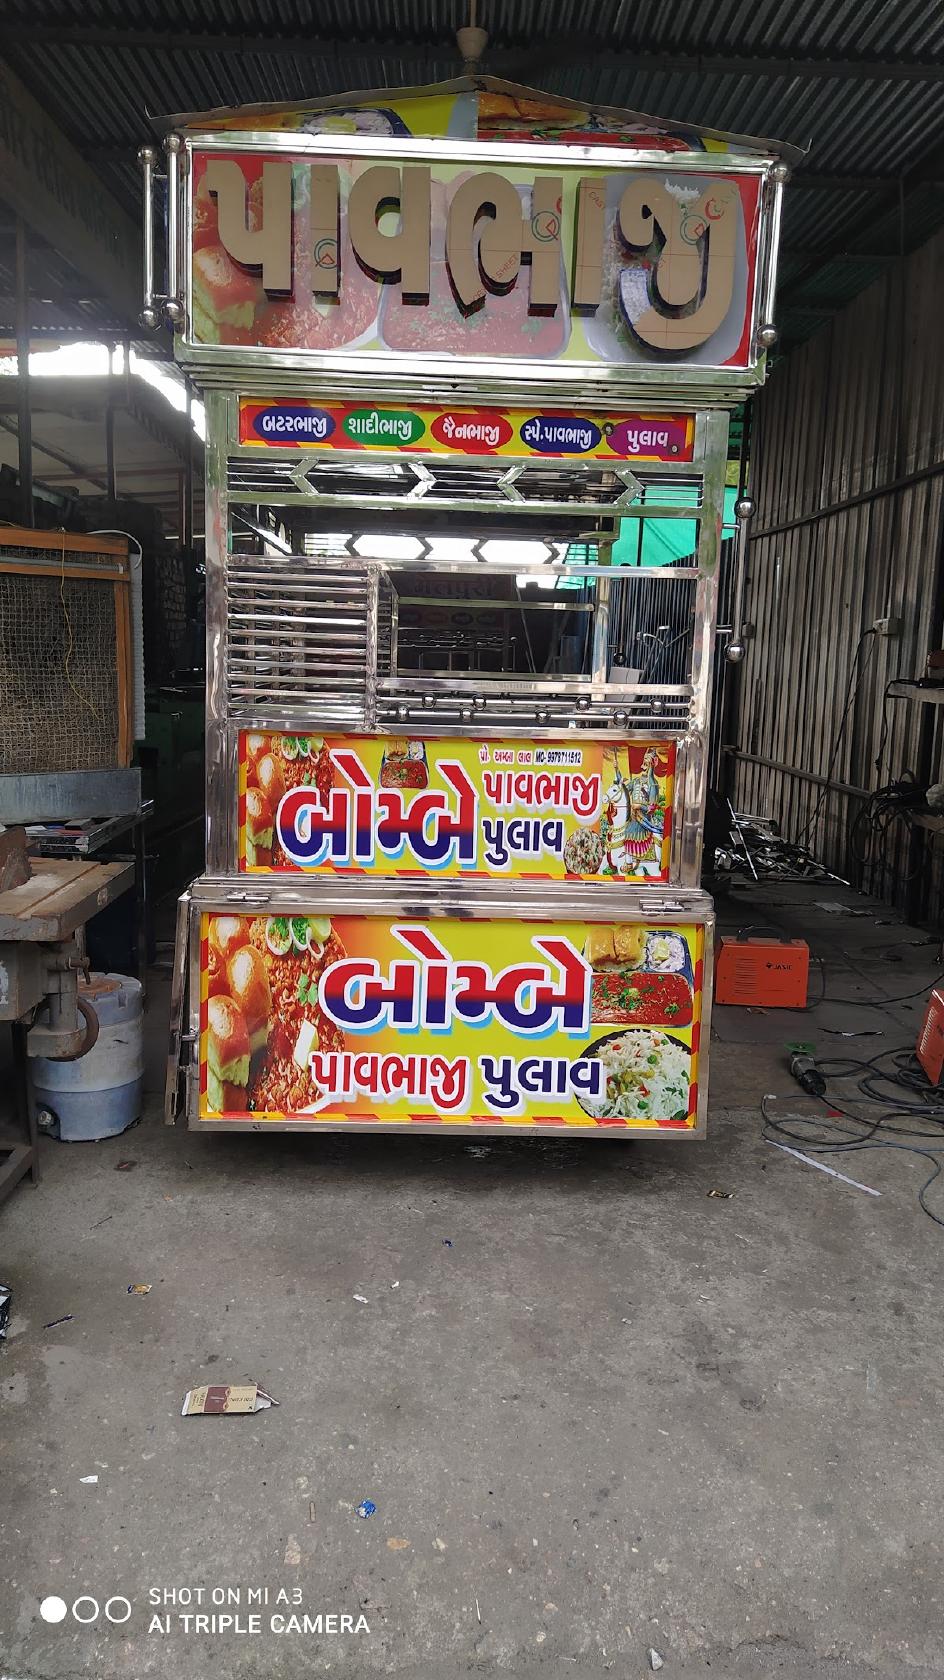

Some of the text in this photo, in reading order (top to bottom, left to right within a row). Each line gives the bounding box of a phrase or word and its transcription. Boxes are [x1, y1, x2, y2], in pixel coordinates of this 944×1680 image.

[206, 159, 737, 352] પાવભાજી
[262, 414, 327, 438] બટરભાજી
[348, 411, 412, 441] શાદીભાજી
[442, 415, 500, 446] જૈનભાજી
[626, 429, 669, 452] પુલાવ
[278, 752, 477, 864] બોમ્બે
[483, 773, 600, 817] પાવભાજી
[482, 819, 563, 866] પુલાવ
[321, 926, 590, 1031] બોમ્બે
[311, 1053, 602, 1109] પાવભાજી પુલાવ
